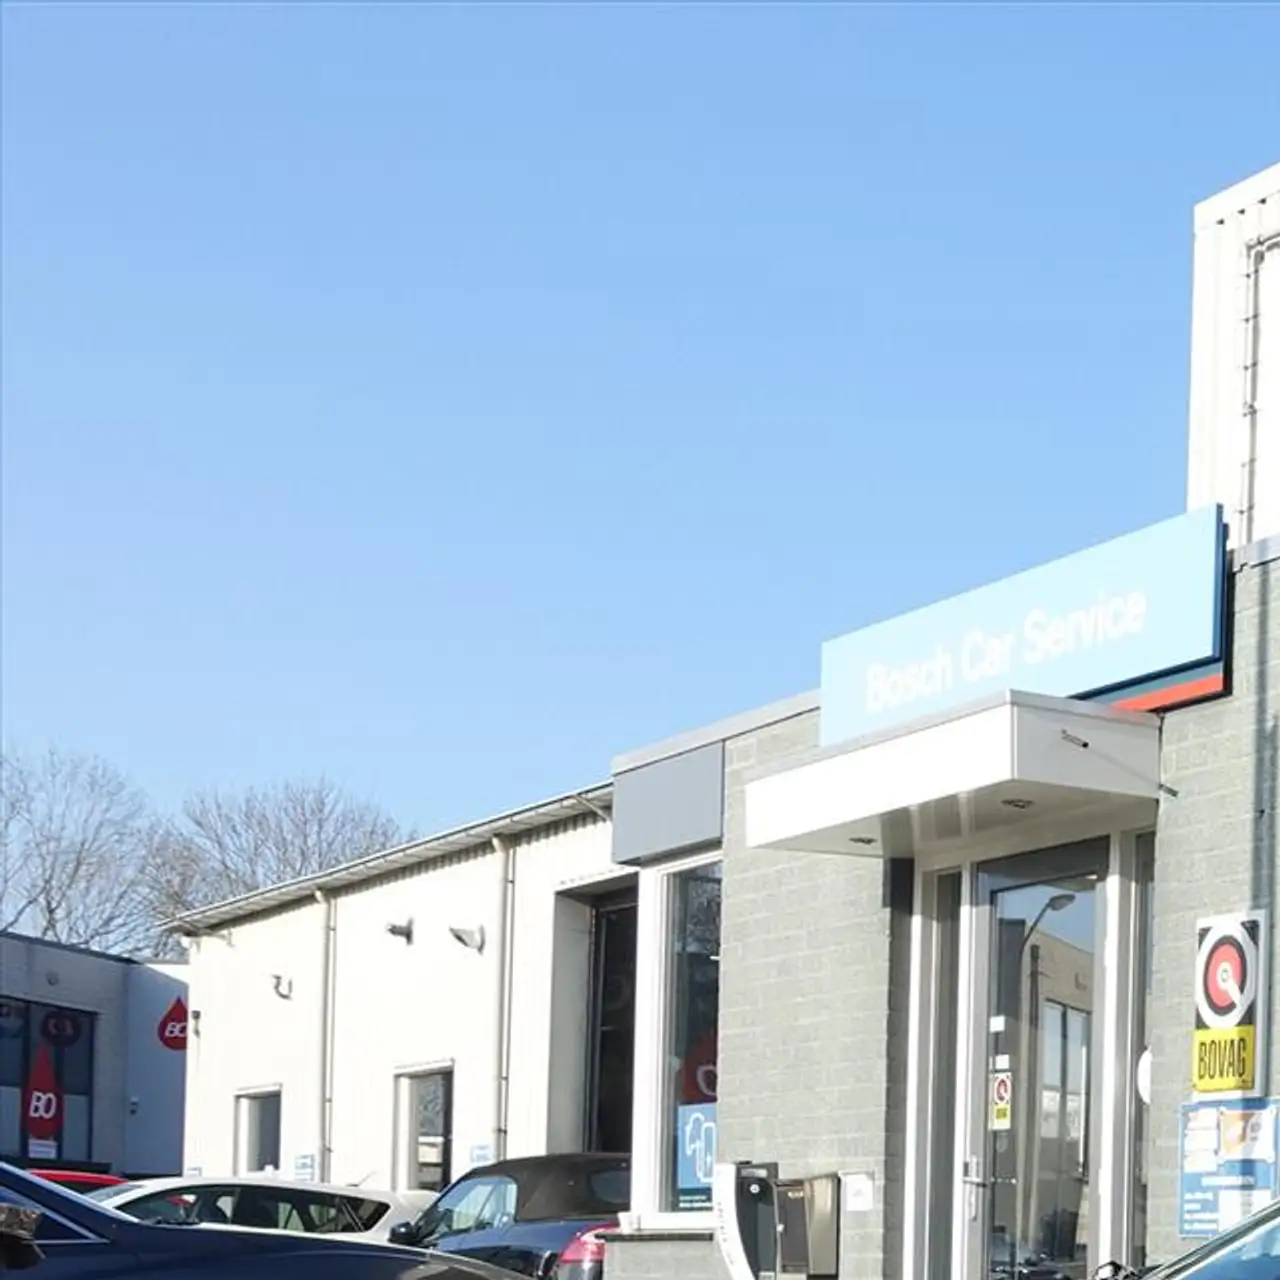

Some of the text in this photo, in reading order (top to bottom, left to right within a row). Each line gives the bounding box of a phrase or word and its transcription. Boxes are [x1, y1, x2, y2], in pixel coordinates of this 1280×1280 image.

[864, 589, 1148, 712] Bosch Car Service
[1198, 1037, 1246, 1080] BOVAG
[29, 1090, 57, 1119] BO
